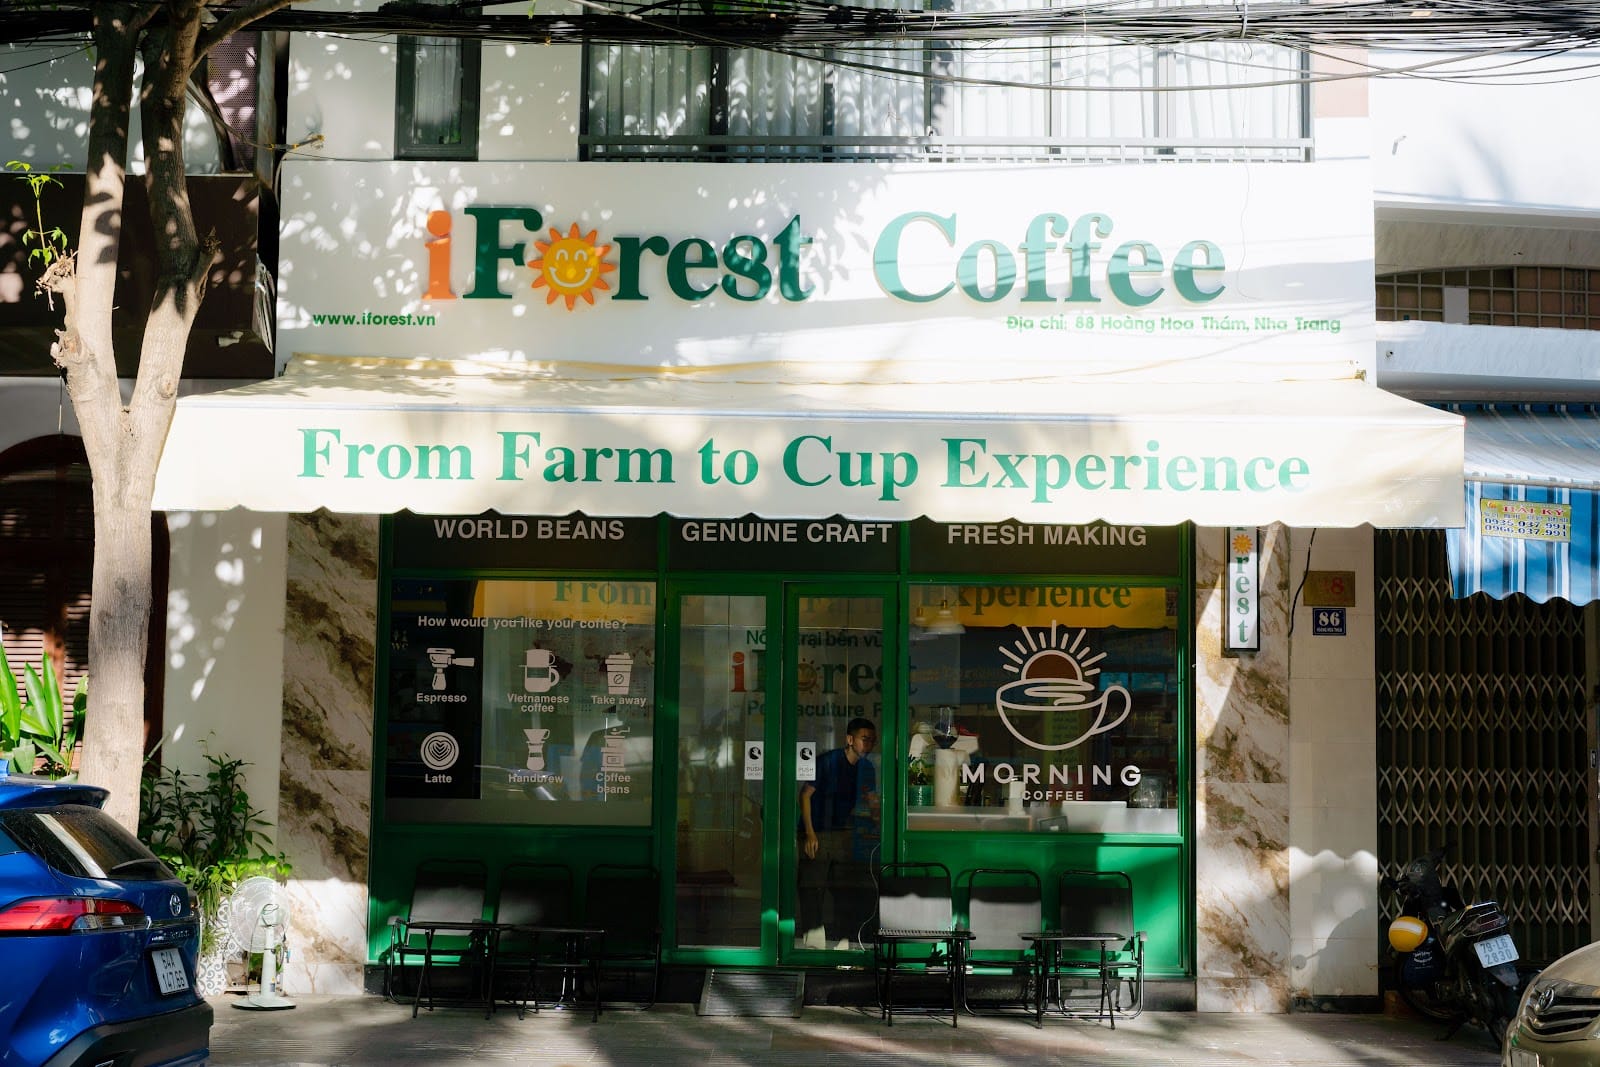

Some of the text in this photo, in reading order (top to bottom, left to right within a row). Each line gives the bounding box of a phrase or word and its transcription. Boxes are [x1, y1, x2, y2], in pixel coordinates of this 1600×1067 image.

[872, 211, 1226, 307] Coffee
[313, 312, 436, 326] www.iforest.vn
[1006, 315, 1035, 333] Địa
[1075, 315, 1095, 329] 88
[1101, 315, 1156, 333] Hoàng
[1161, 316, 1195, 330] Hoa
[1201, 315, 1249, 332] Thám,
[1254, 317, 1288, 331] Nha
[1294, 316, 1341, 333] Trang
[296, 428, 1311, 504] From Farm to Cup Experience
[434, 519, 625, 540] WORLD BEANS
[681, 522, 893, 543] GENUINE CRAFT
[947, 525, 1147, 546] FRESH MAKING
[417, 616, 628, 631] How would you like your coffee?
[1318, 611, 1340, 627] 86
[416, 693, 467, 705] Espresso
[507, 693, 570, 703] Vietnamese
[591, 695, 647, 707] Take away
[520, 703, 555, 713] coffee
[424, 773, 453, 784] Latte
[508, 773, 564, 784] Handbrew
[595, 772, 631, 783] Coffee
[962, 763, 1142, 787] MORNING
[596, 784, 630, 794] beans
[1023, 790, 1084, 801] COFFEE
[1484, 948, 1513, 965] 2830
